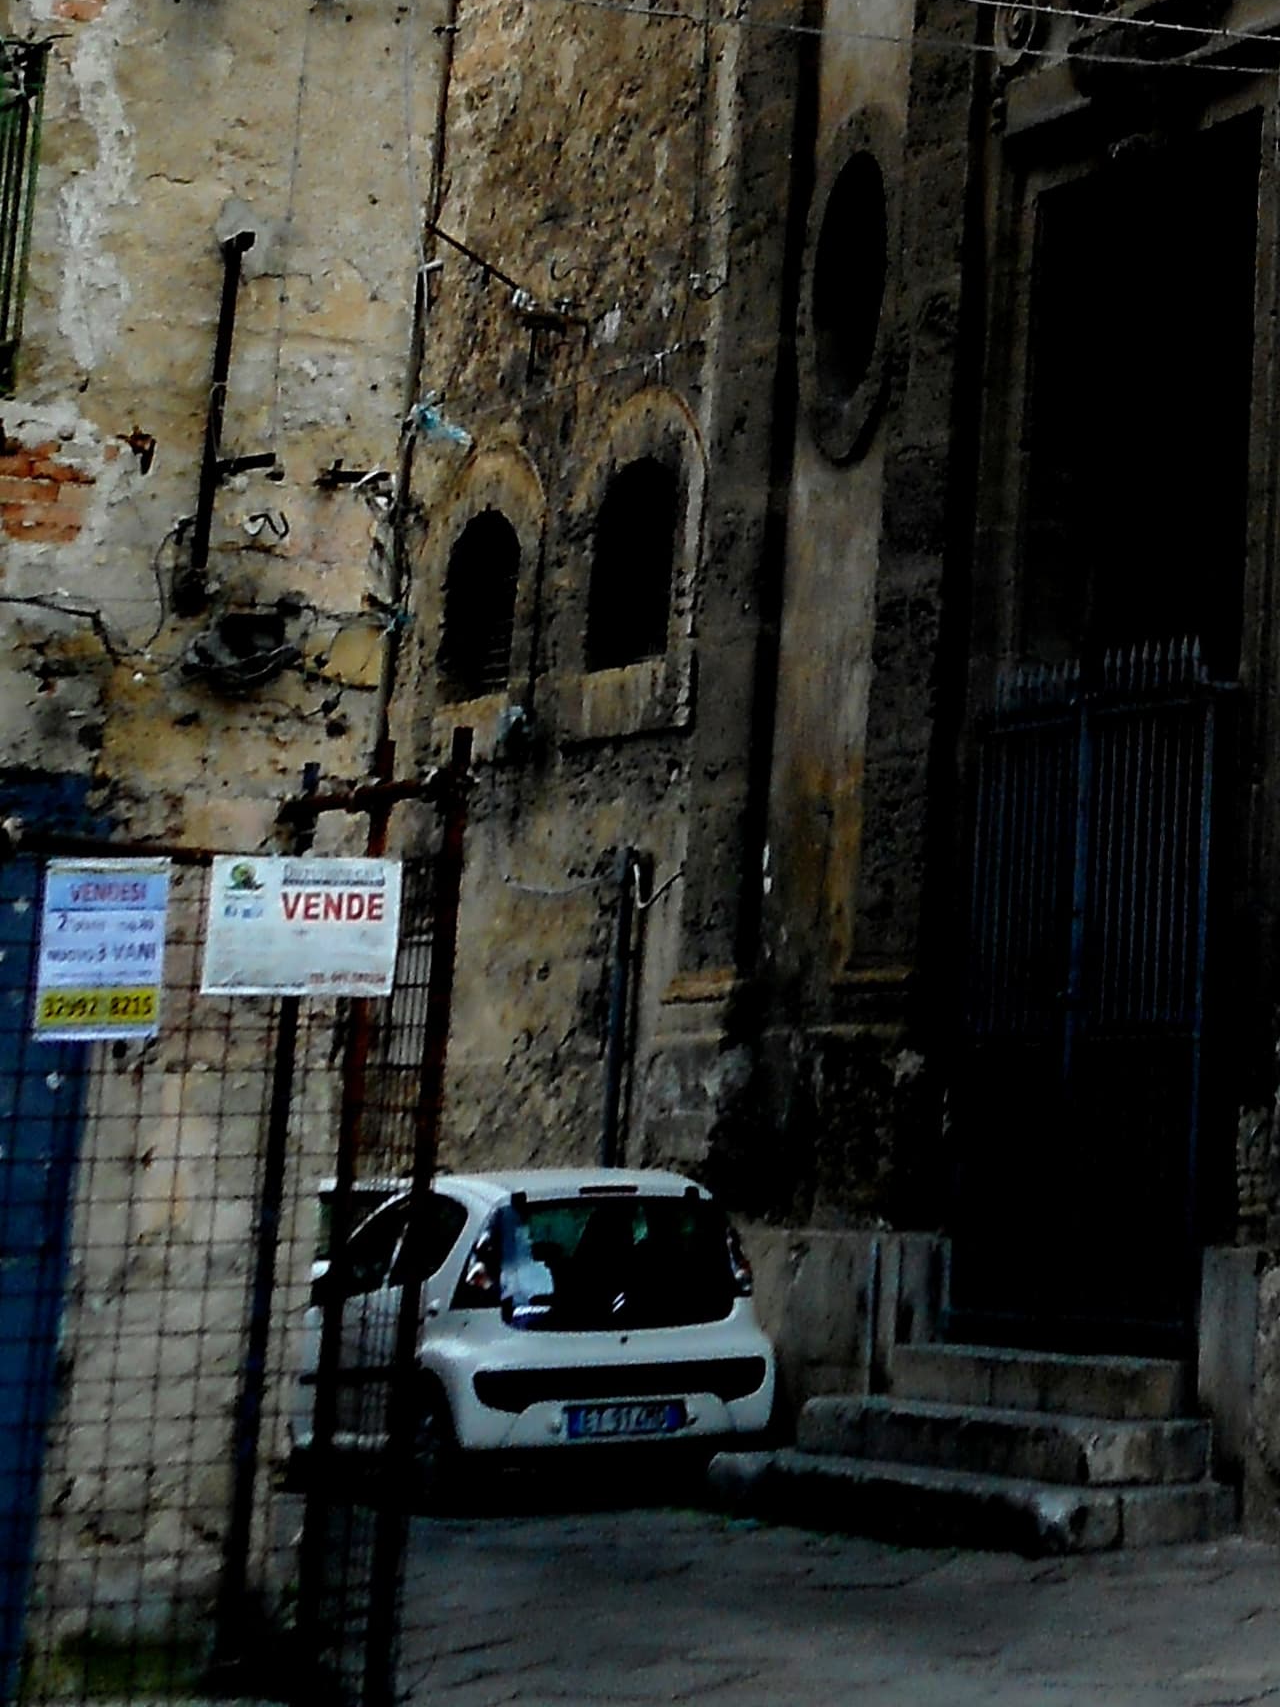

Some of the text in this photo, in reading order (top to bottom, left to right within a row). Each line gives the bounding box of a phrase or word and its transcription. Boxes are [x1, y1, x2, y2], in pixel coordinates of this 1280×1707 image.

[70, 881, 147, 903] VENDESI
[281, 892, 385, 921] VENDE
[111, 941, 156, 962] VANI
